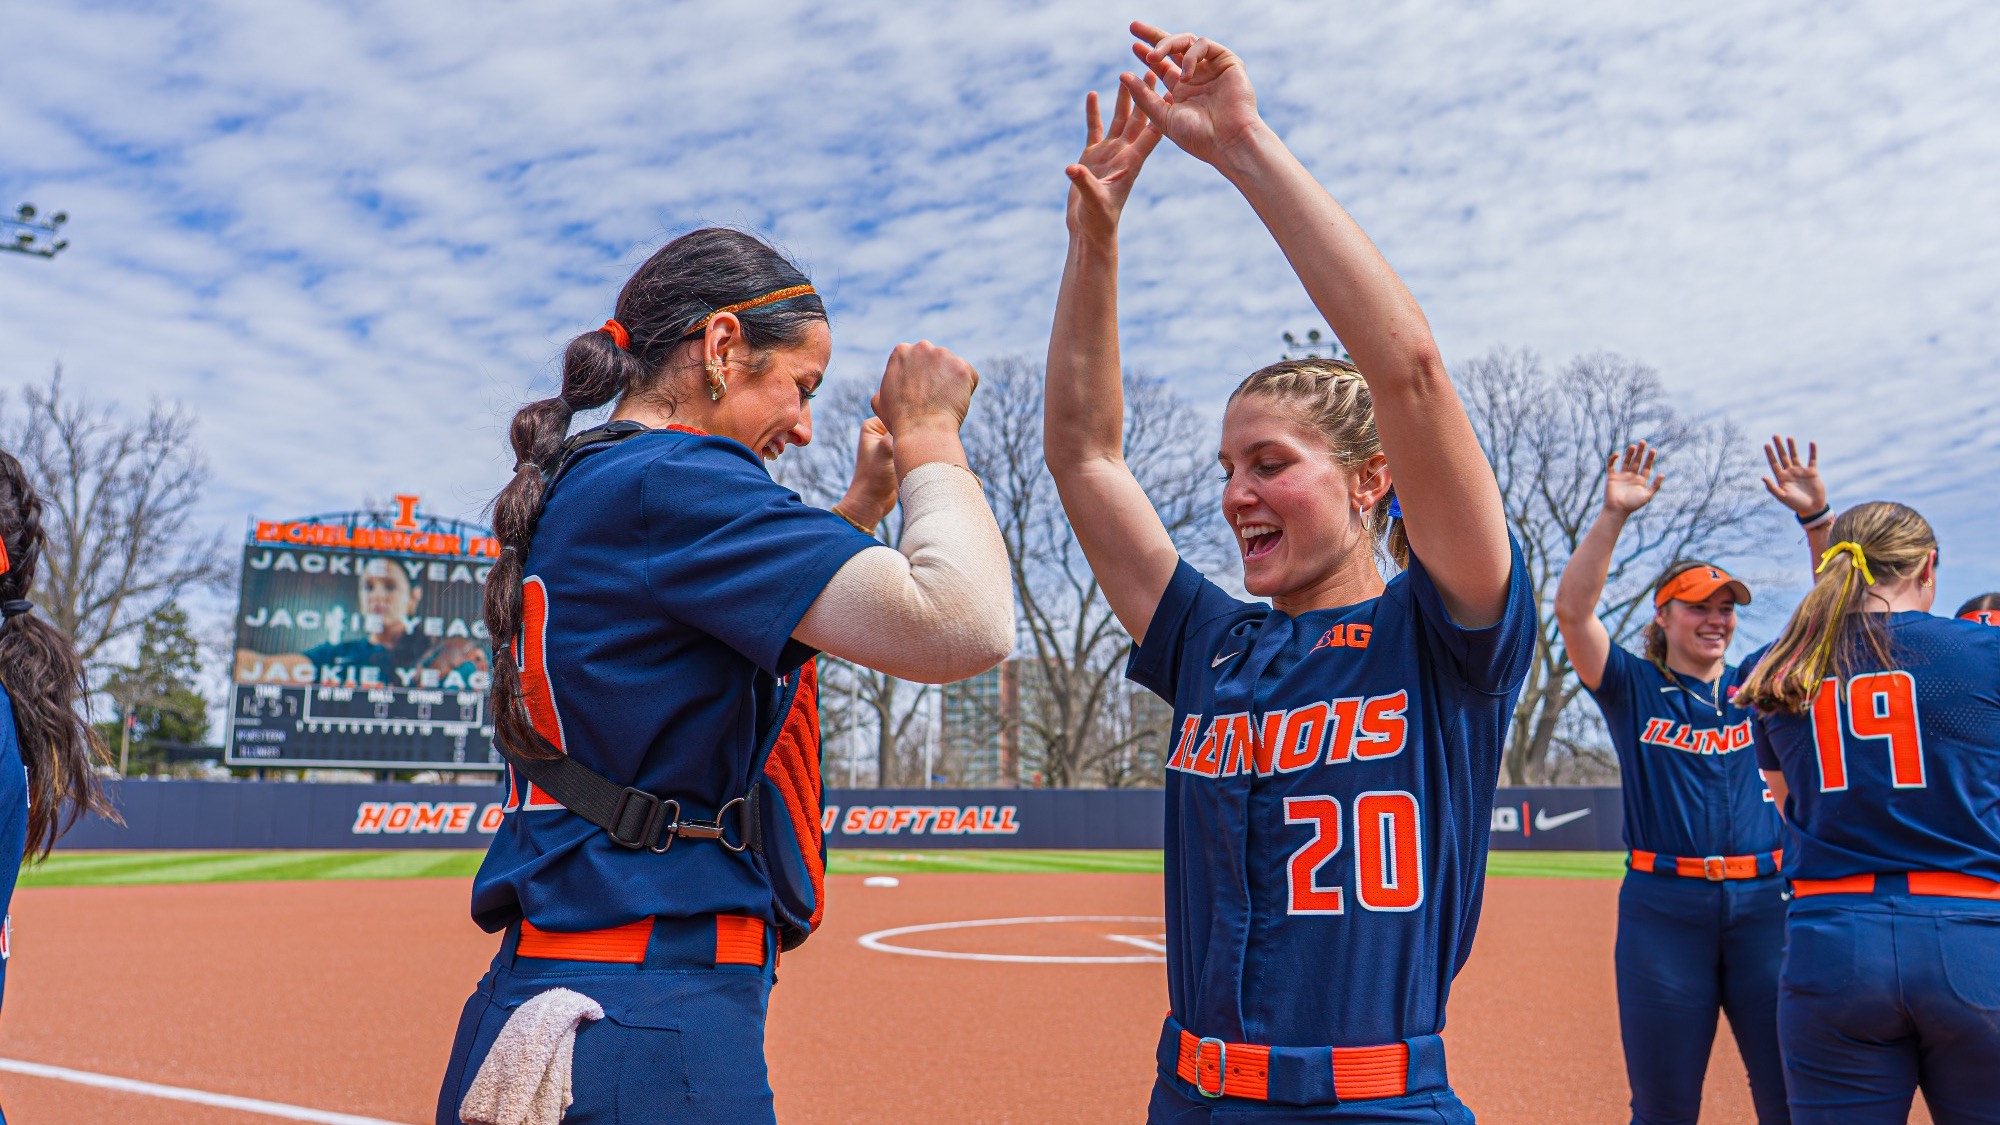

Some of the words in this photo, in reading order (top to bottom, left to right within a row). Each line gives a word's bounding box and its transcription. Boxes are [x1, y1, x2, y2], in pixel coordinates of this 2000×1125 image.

[250, 550, 388, 576] JACKIE
[240, 660, 381, 686] JACKIE
[1639, 716, 1754, 755] ILLINO
[1810, 670, 1927, 793] 19
[352, 802, 477, 834] HOME
[842, 806, 1020, 834] SOFTBALL
[1282, 790, 1425, 917] 20
